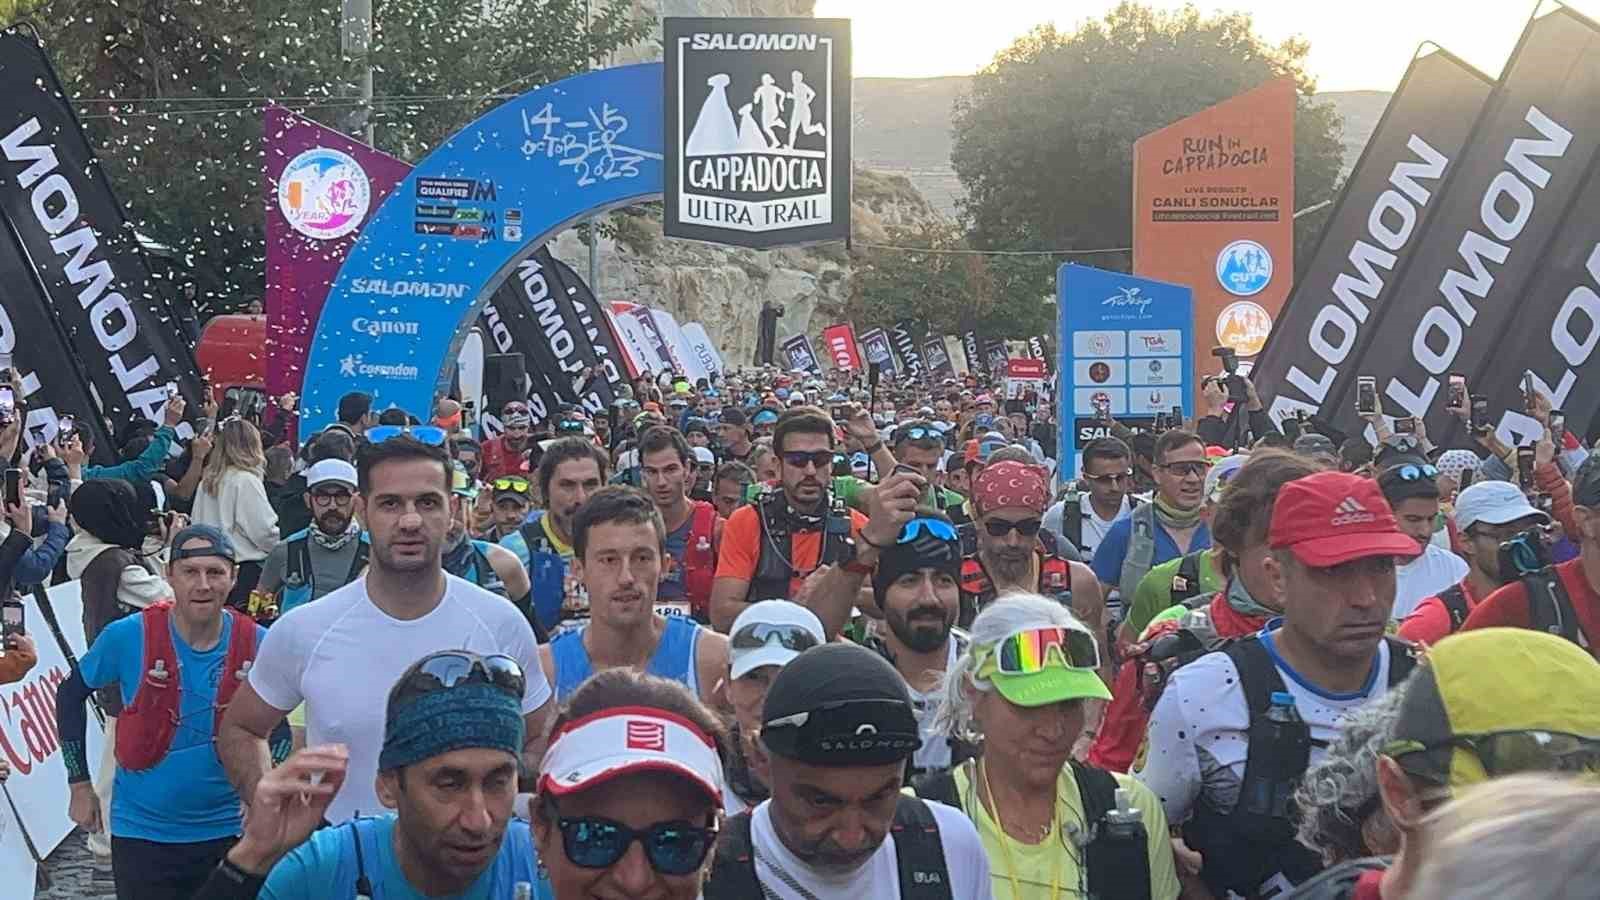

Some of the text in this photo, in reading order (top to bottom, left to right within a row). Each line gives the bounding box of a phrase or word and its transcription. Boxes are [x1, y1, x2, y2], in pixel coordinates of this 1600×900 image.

[691, 33, 817, 50] SALOMON
[1183, 133, 1223, 153] RUN
[1162, 148, 1268, 174] CAPPADOCIA
[577, 156, 645, 187] 2023
[688, 156, 824, 192] CAPPADOCIA
[420, 187, 469, 197] QUALIFIER
[687, 198, 822, 225] ULTRA TRAIL
[1152, 197, 1196, 208] CANLI
[1269, 134, 1449, 438] ALOMON
[1364, 105, 1574, 448] LOMON
[350, 278, 470, 298] SALOMON
[352, 317, 419, 336] Canon
[1331, 512, 1376, 526] adidas
